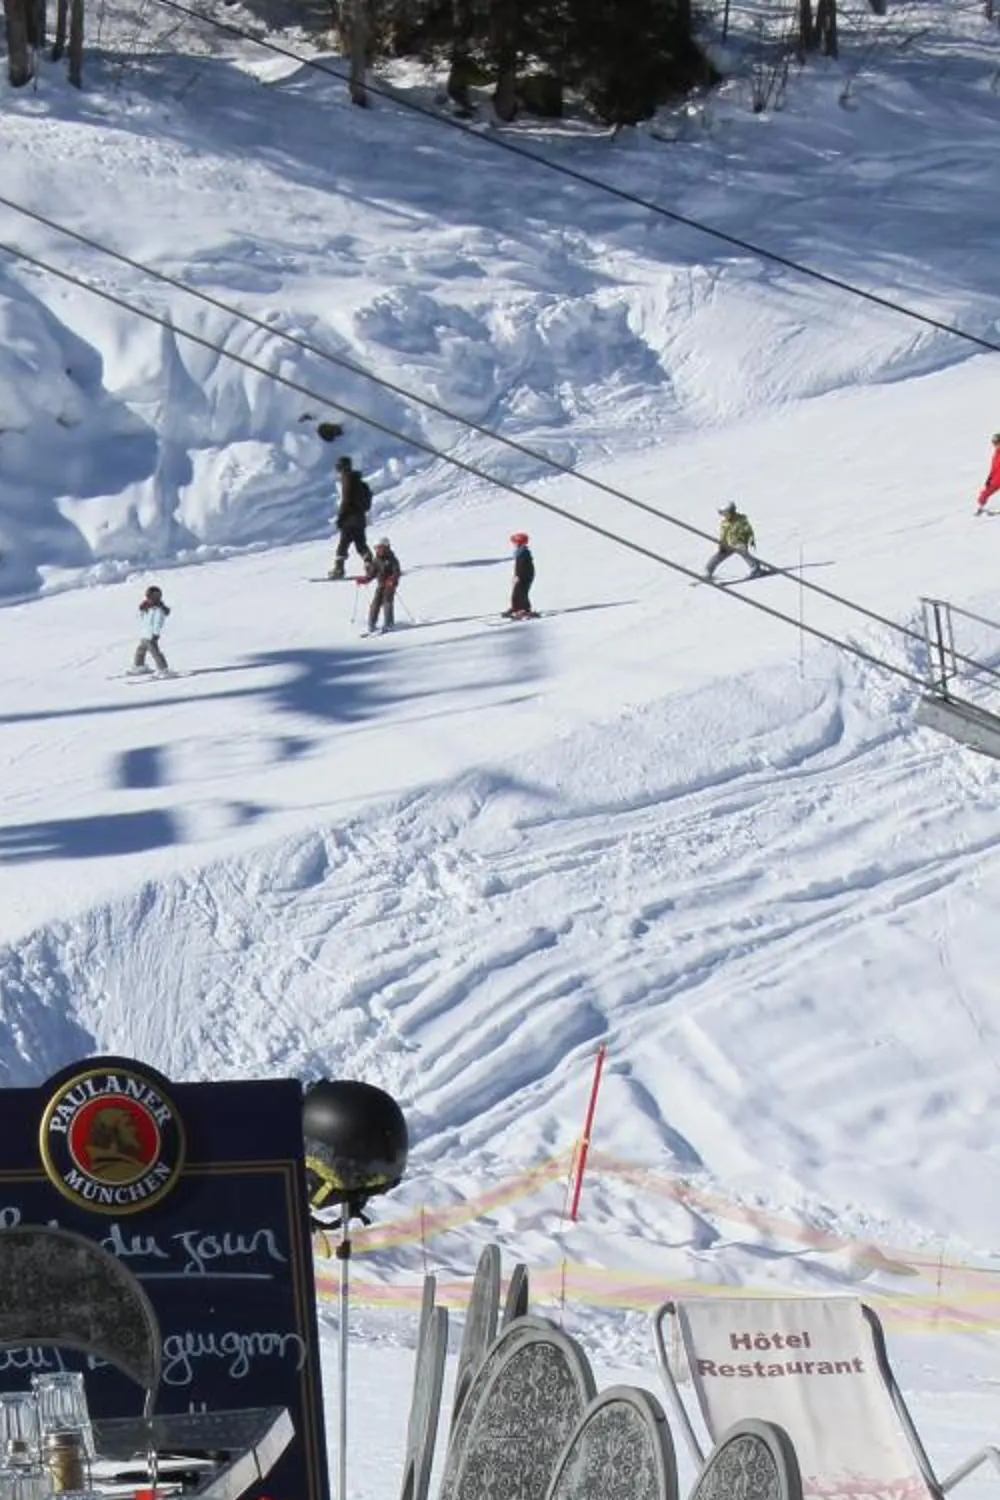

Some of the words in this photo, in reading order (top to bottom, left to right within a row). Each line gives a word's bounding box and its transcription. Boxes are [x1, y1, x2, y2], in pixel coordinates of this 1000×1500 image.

[50, 1075, 172, 1134] PAULANER
[100, 1223, 169, 1258] du
[729, 1331, 812, 1351] Hôtel
[696, 1357, 865, 1378] Restaurant
